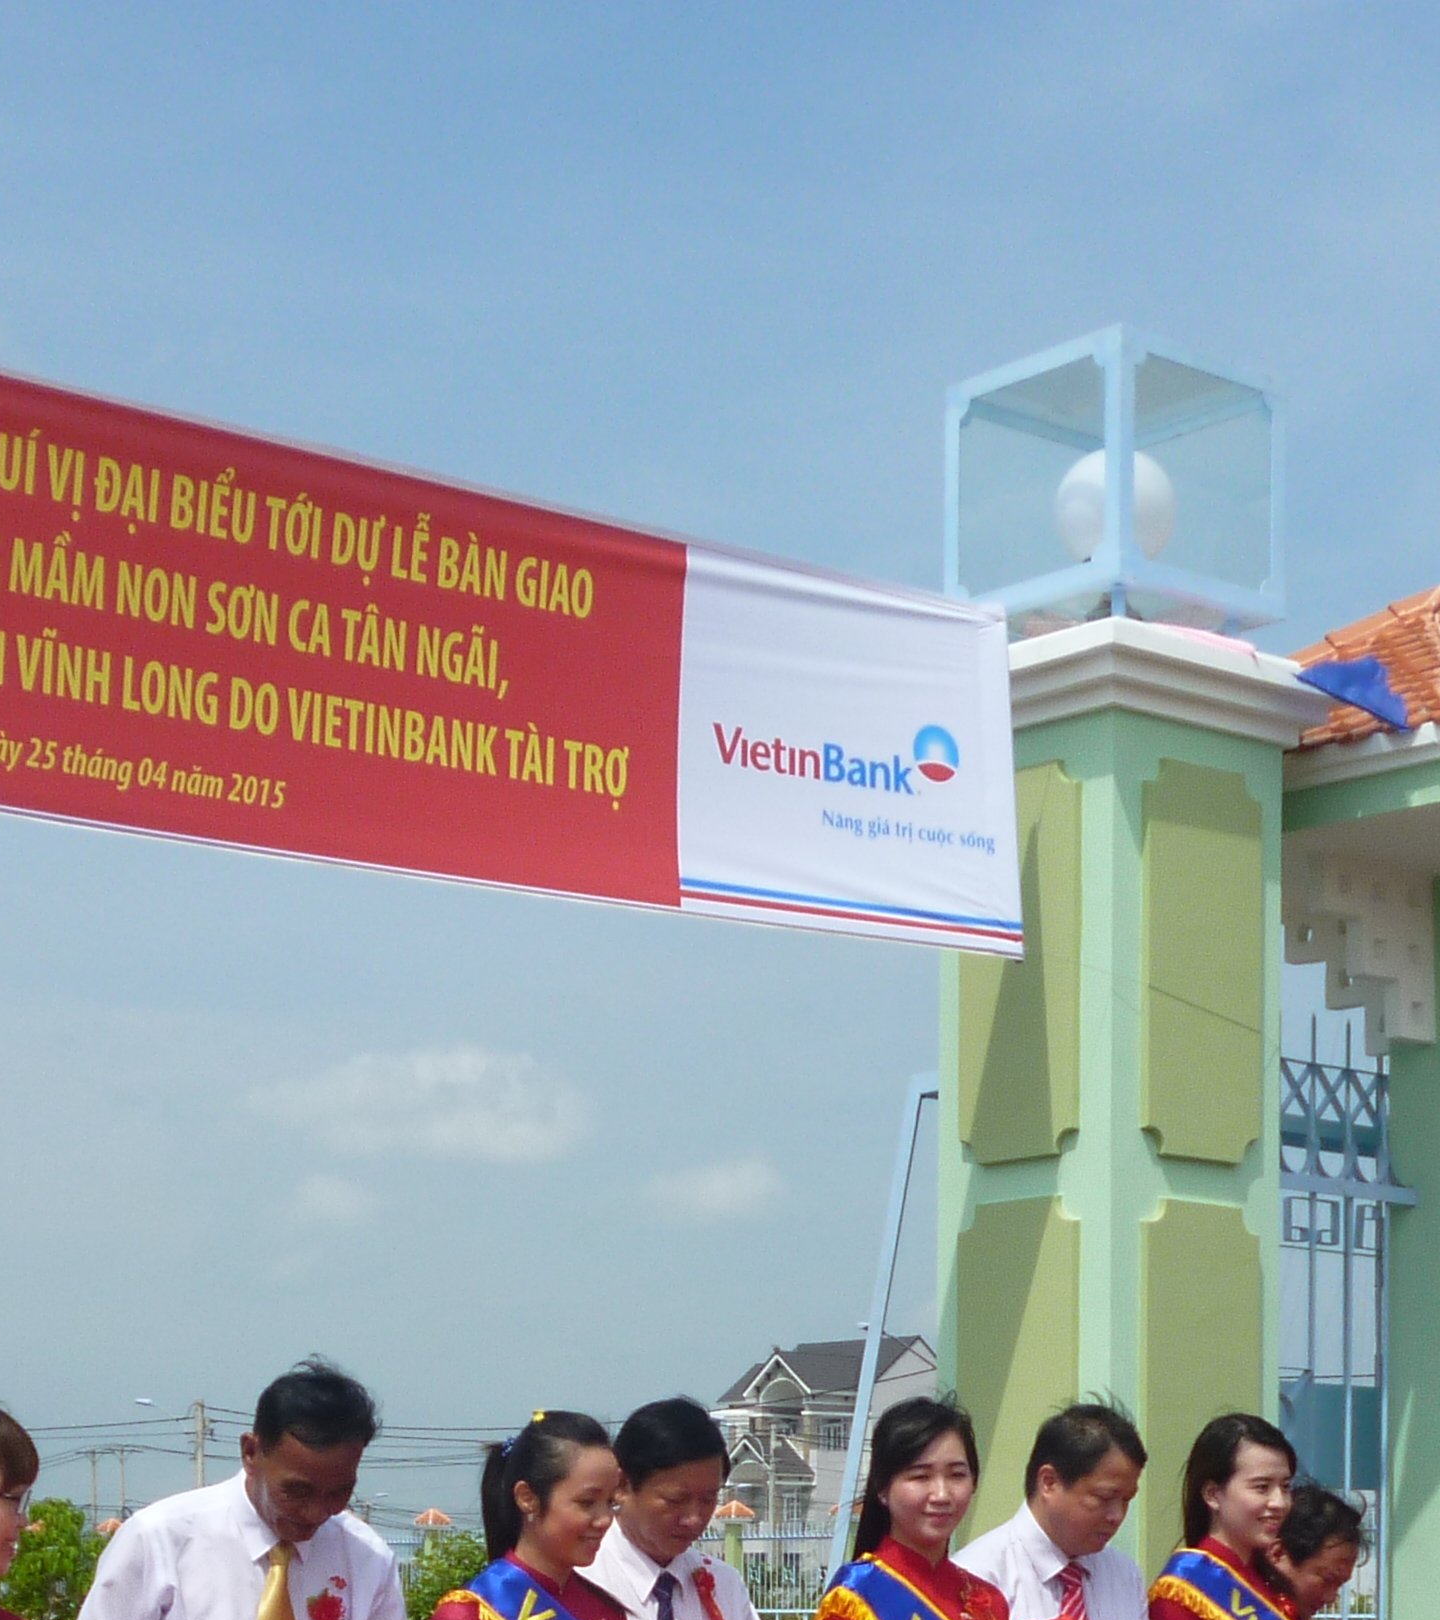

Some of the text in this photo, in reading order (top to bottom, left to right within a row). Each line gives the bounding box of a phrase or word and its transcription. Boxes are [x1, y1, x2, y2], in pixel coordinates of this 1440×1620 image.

[47, 444, 85, 522] VỊ
[94, 456, 160, 535] ĐẠI
[170, 467, 257, 544] BIỂU
[265, 492, 323, 560] TỚI
[331, 512, 386, 587] DỰ
[391, 512, 431, 584] LỄ
[437, 532, 508, 601] BÀN
[515, 556, 594, 619] GIAO
[8, 531, 105, 611] MẦM
[116, 560, 197, 630] NON
[205, 581, 279, 646] SƠN
[288, 598, 331, 658] CA
[341, 603, 407, 673] TÂN
[416, 624, 509, 700] NGÃI,
[16, 627, 111, 706] VĨNH
[122, 655, 219, 726] LONG
[228, 676, 280, 736] DO
[287, 687, 498, 777] VIETINBANK
[504, 722, 556, 786] TÀI
[563, 739, 630, 812] TRỢ
[25, 737, 58, 770] 25
[62, 743, 134, 792] tháng
[137, 757, 168, 790] 04
[170, 765, 224, 800] năm
[226, 773, 287, 809] 2015
[712, 721, 914, 795] VietinBank
[821, 808, 996, 855] Nâng giá trị cuộc sống
